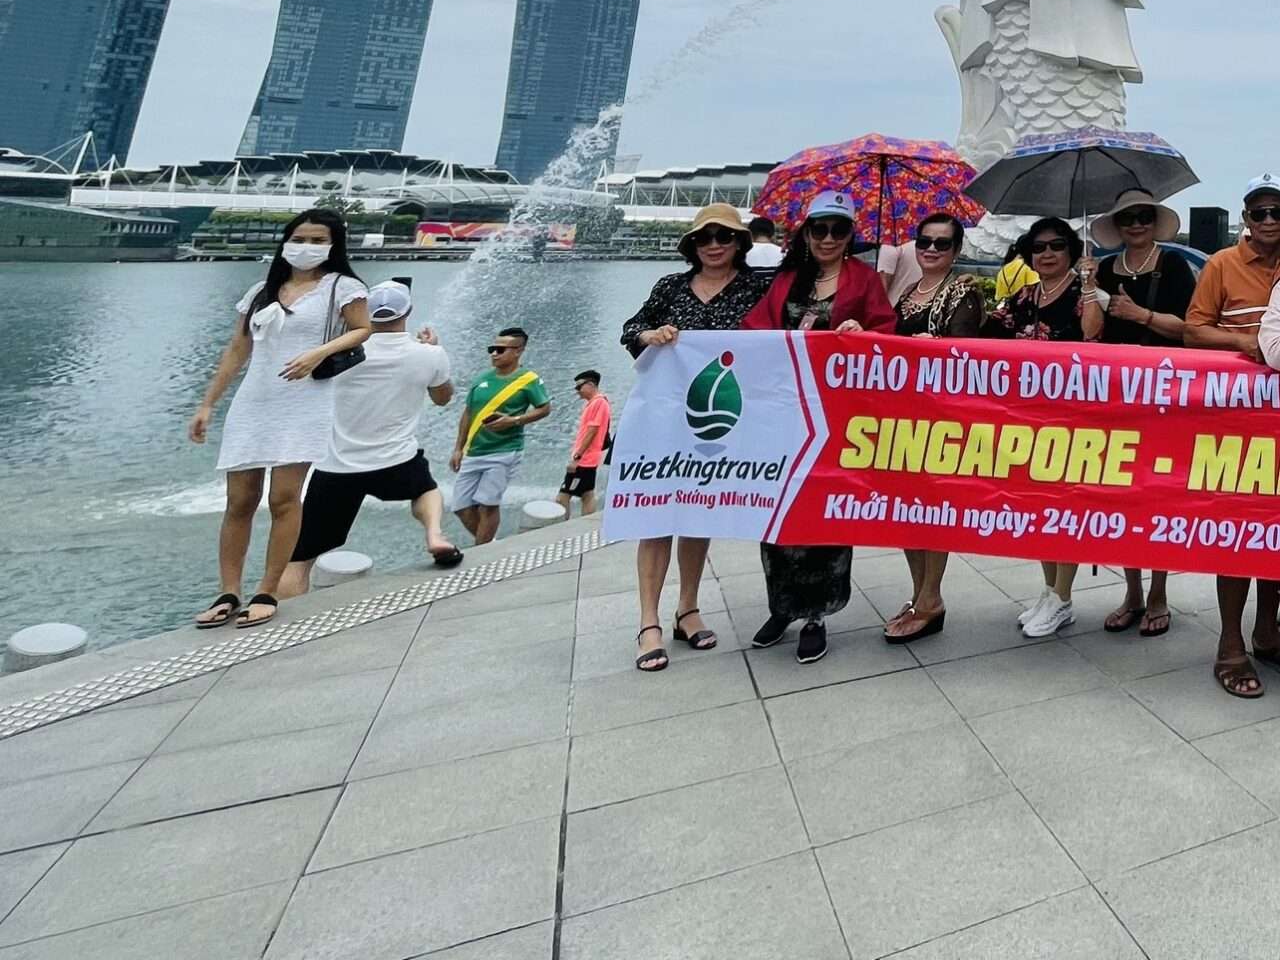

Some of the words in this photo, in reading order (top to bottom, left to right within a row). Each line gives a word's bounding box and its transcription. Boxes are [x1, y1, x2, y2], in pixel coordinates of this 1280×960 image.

[826, 344, 909, 392] CHÀO
[916, 346, 1010, 397] MỪNG
[1018, 352, 1111, 402] ĐOÀN
[1121, 357, 1196, 414] VIỆT
[1204, 371, 1280, 409] NAM
[619, 451, 787, 486] vietkingtravel
[839, 415, 1142, 486] SINGAPORE
[612, 492, 630, 509] Đi
[633, 492, 672, 508] Tour
[750, 493, 775, 509] Vua
[824, 492, 888, 521] Khởi
[892, 497, 957, 527] hành
[962, 504, 1037, 538] ngày:
[1041, 508, 1126, 540] 24/09
